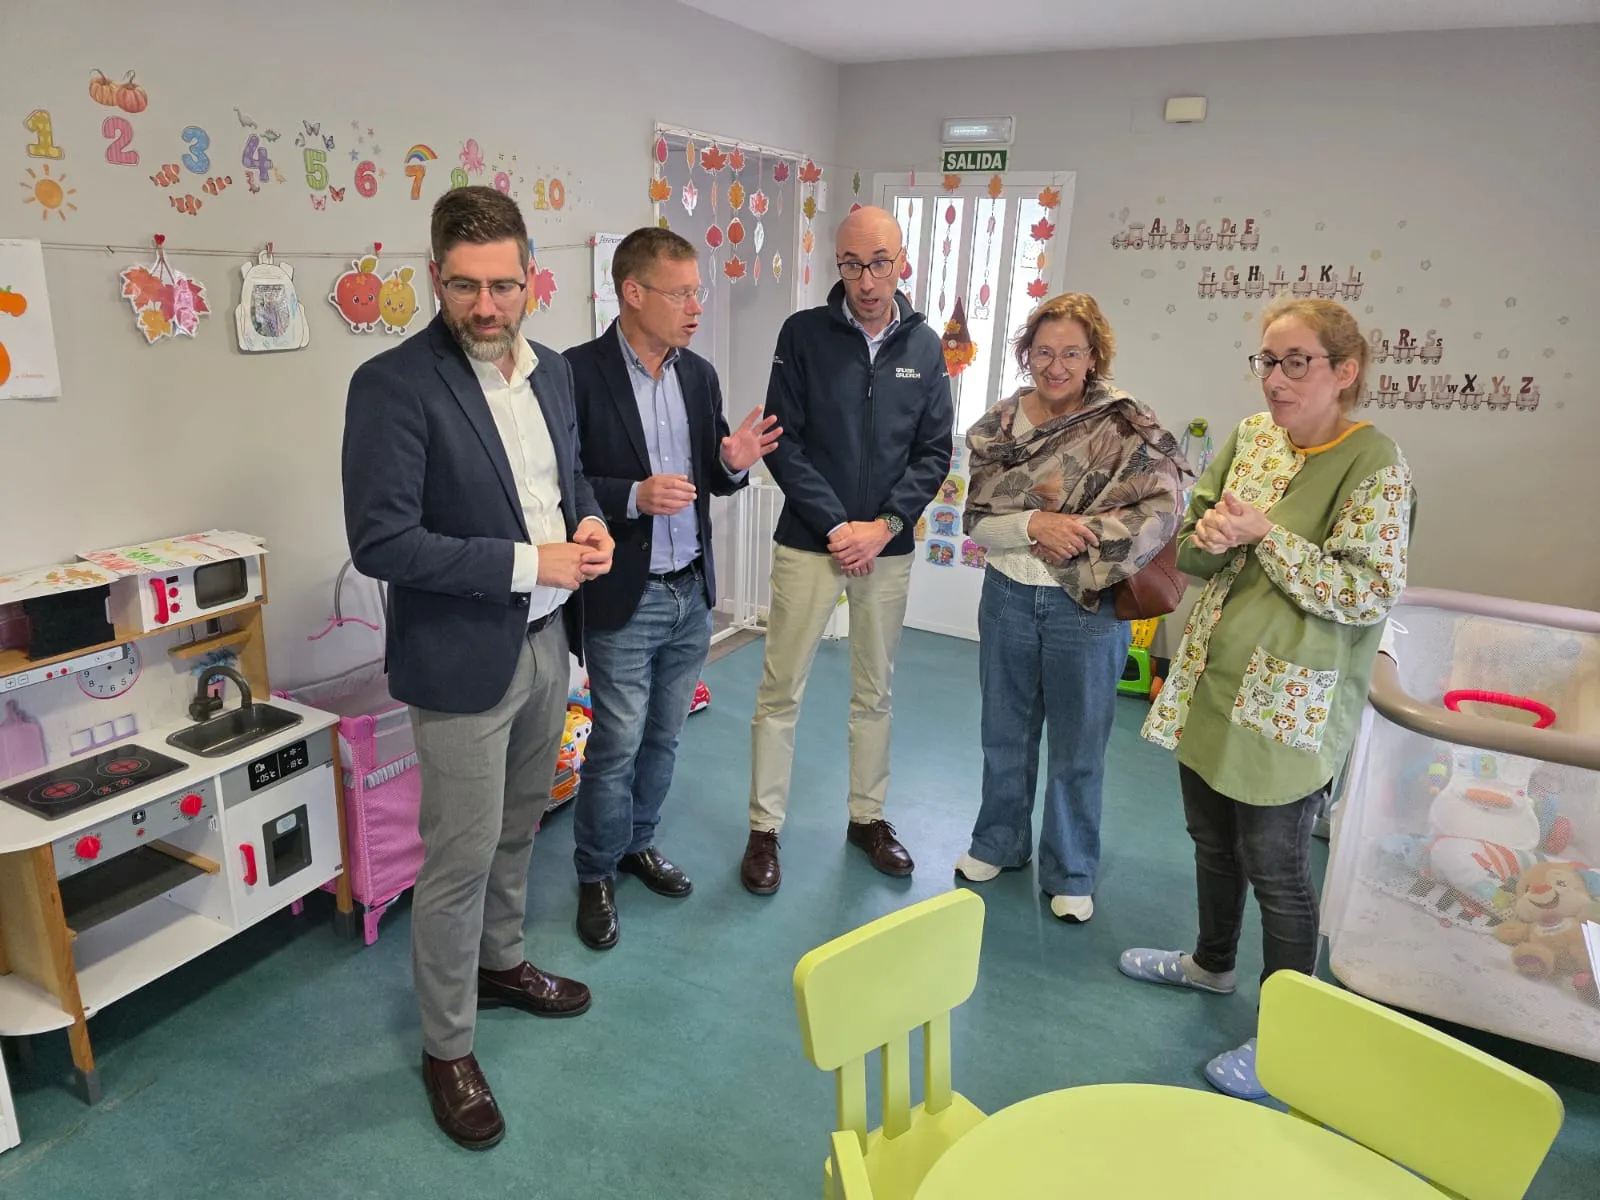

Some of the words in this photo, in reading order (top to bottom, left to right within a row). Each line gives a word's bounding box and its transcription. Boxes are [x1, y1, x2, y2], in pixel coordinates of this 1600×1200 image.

[25, 109, 64, 160] 1
[102, 115, 139, 166] 2
[181, 126, 210, 174] 3
[242, 134, 273, 182] 4
[303, 148, 328, 190] 5
[354, 160, 377, 197] 6
[405, 164, 425, 200] 7
[533, 178, 565, 211] 10
[946, 152, 1002, 170] SALIDA
[83, 670, 90, 678] 9
[110, 684, 116, 692] 6
